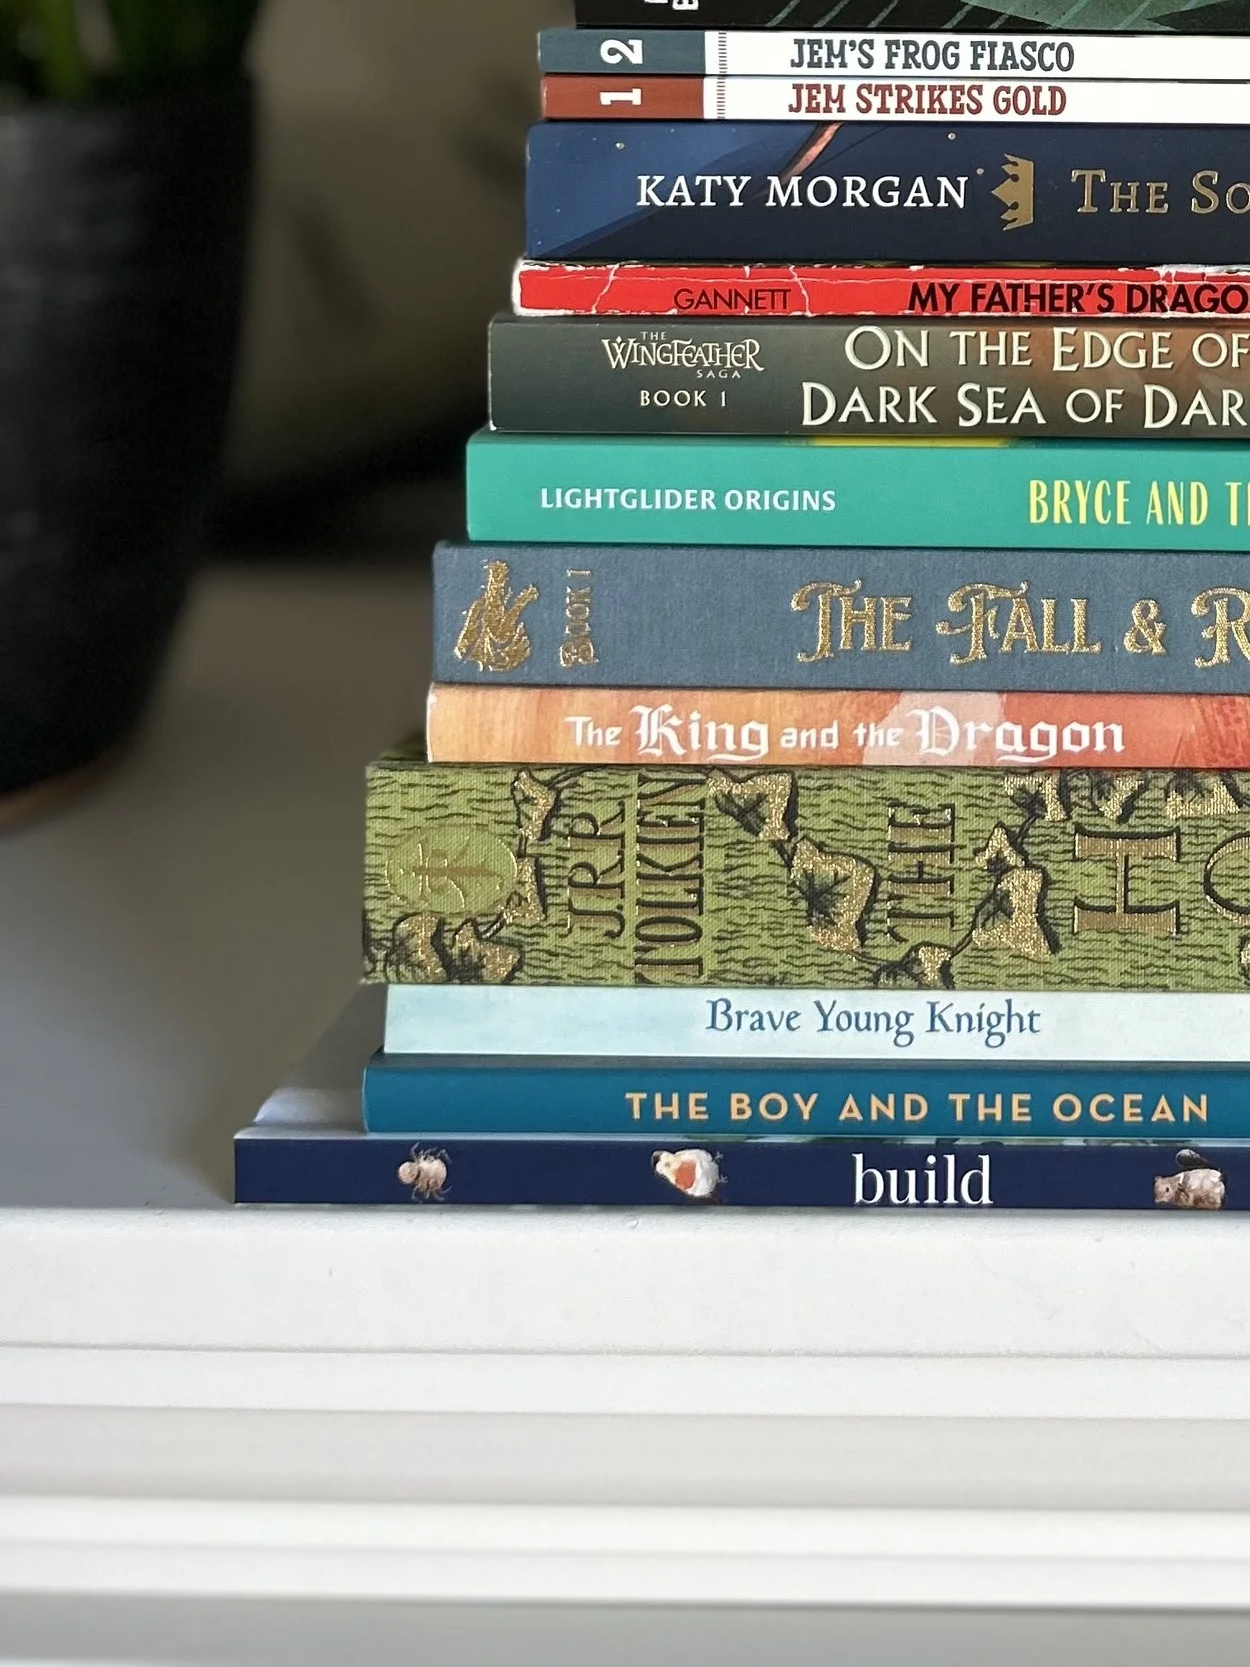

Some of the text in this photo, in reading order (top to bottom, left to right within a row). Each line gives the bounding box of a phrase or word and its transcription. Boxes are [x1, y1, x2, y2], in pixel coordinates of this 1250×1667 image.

[602, 39, 642, 64] 2
[884, 40, 960, 70] FROG
[971, 41, 1074, 72] FIASCO
[600, 88, 641, 107] 1
[788, 83, 1067, 115] JEM STRIKES GOLD
[636, 175, 968, 208] KATY MORGAN
[1073, 171, 1168, 215] THE
[674, 288, 790, 310] GANNETT
[908, 284, 959, 311] MY
[640, 332, 666, 341] THE
[845, 326, 934, 369] ON
[950, 328, 1031, 366] THE
[1051, 328, 1172, 370] EDGE
[1194, 333, 1249, 367] OF
[697, 370, 742, 378] SAGA
[640, 391, 707, 407] BOOK
[801, 383, 937, 428] DARK
[958, 383, 1046, 426] SEA
[1066, 389, 1124, 425] OF
[541, 487, 836, 511] LIGHTGLIDER ORIGINS
[1028, 479, 1131, 526] BRYCE
[1146, 481, 1209, 526] AND
[791, 578, 913, 665] THE
[937, 579, 1102, 666] FALL
[1124, 600, 1166, 655] &
[565, 706, 1124, 764] The King and the Dragon
[634, 772, 710, 986] TOLKIEN
[887, 800, 956, 940] THE
[707, 999, 1042, 1048] Brave Young Knight
[626, 1092, 1209, 1123] THE BOY AND THE OCEAN
[853, 1153, 994, 1205] build
